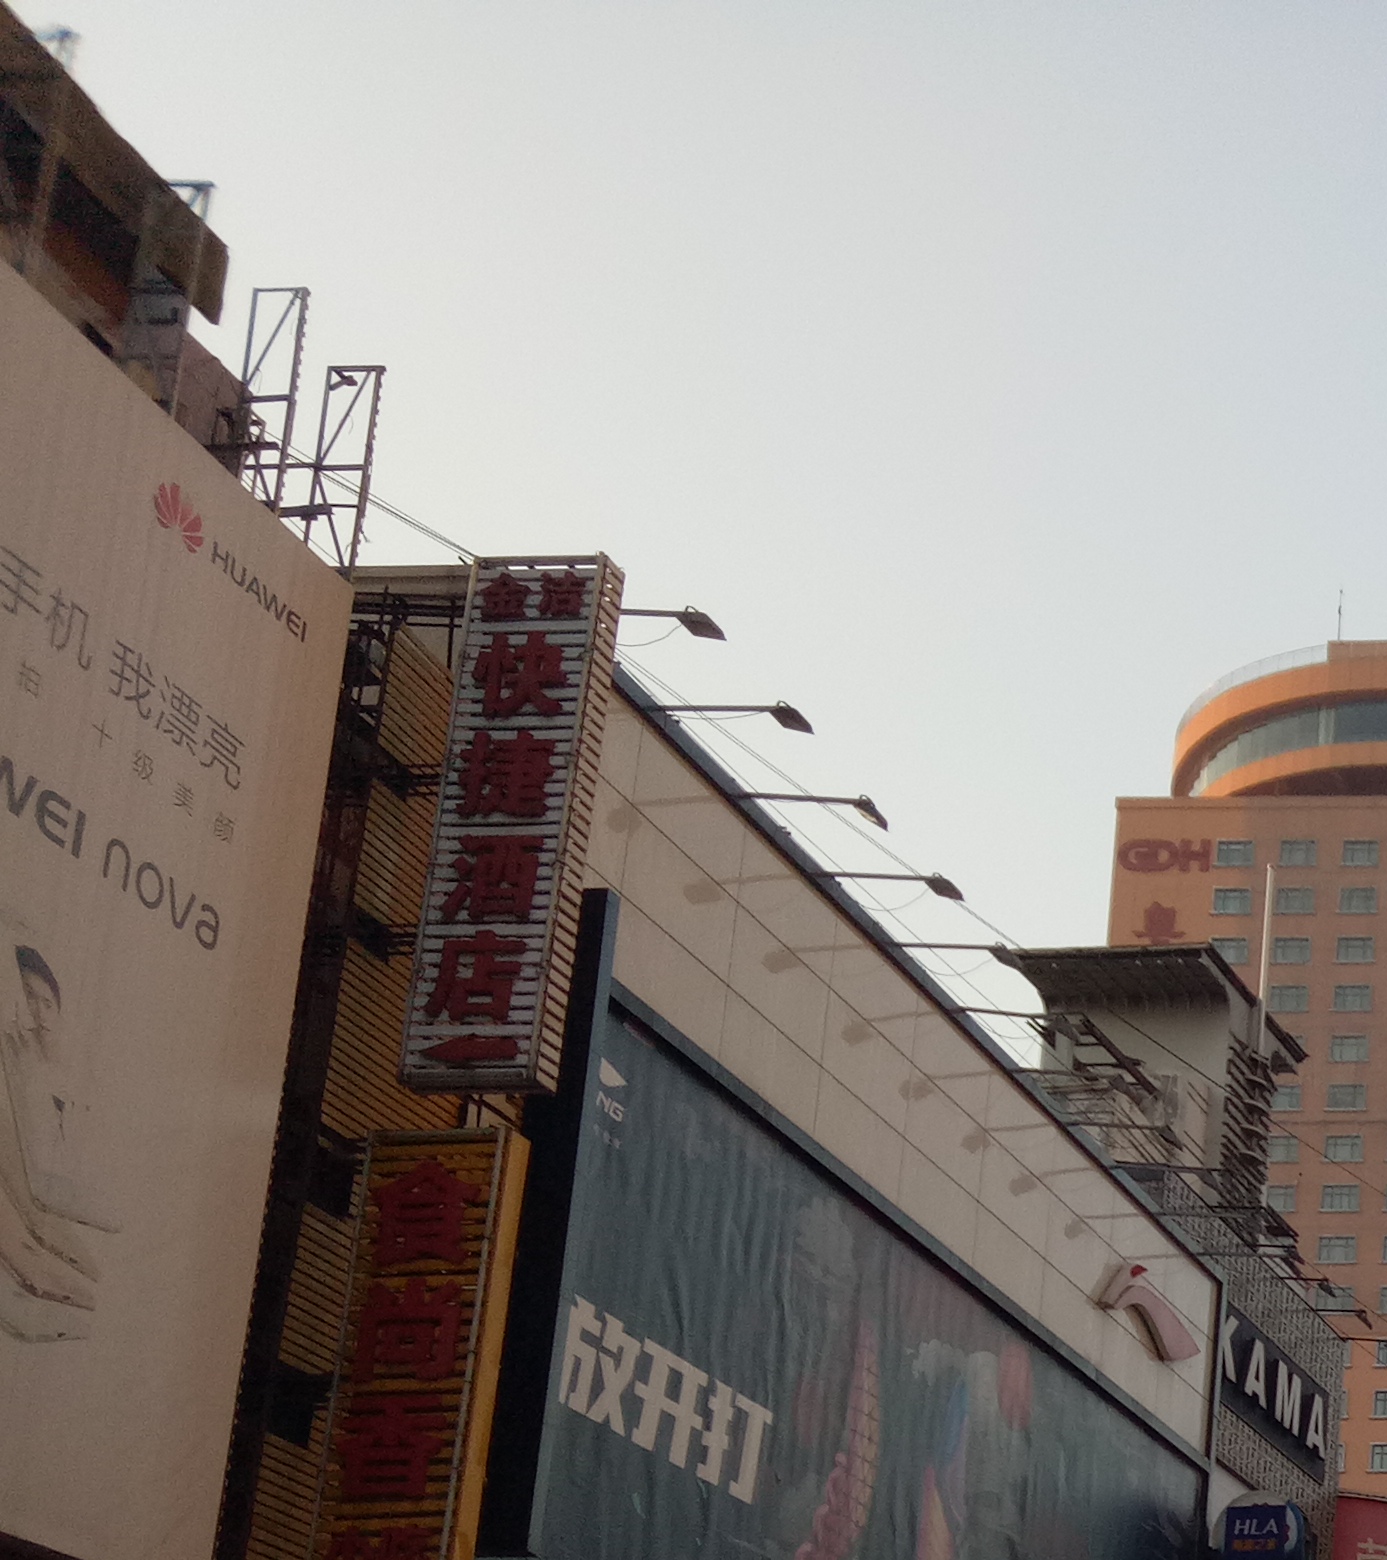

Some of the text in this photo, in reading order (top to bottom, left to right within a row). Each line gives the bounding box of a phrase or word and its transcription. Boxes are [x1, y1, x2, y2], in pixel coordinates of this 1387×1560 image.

[211, 541, 308, 643] HUAWEI
[108, 639, 246, 790] 我漂亮
[424, 631, 567, 1023] 快捷酒店
[1118, 838, 1212, 873] GDH
[102, 838, 221, 950] nova
[558, 1294, 773, 1505] 放开打
[1221, 1314, 1326, 1461] KAMA
[1233, 1517, 1279, 1536] HLA
